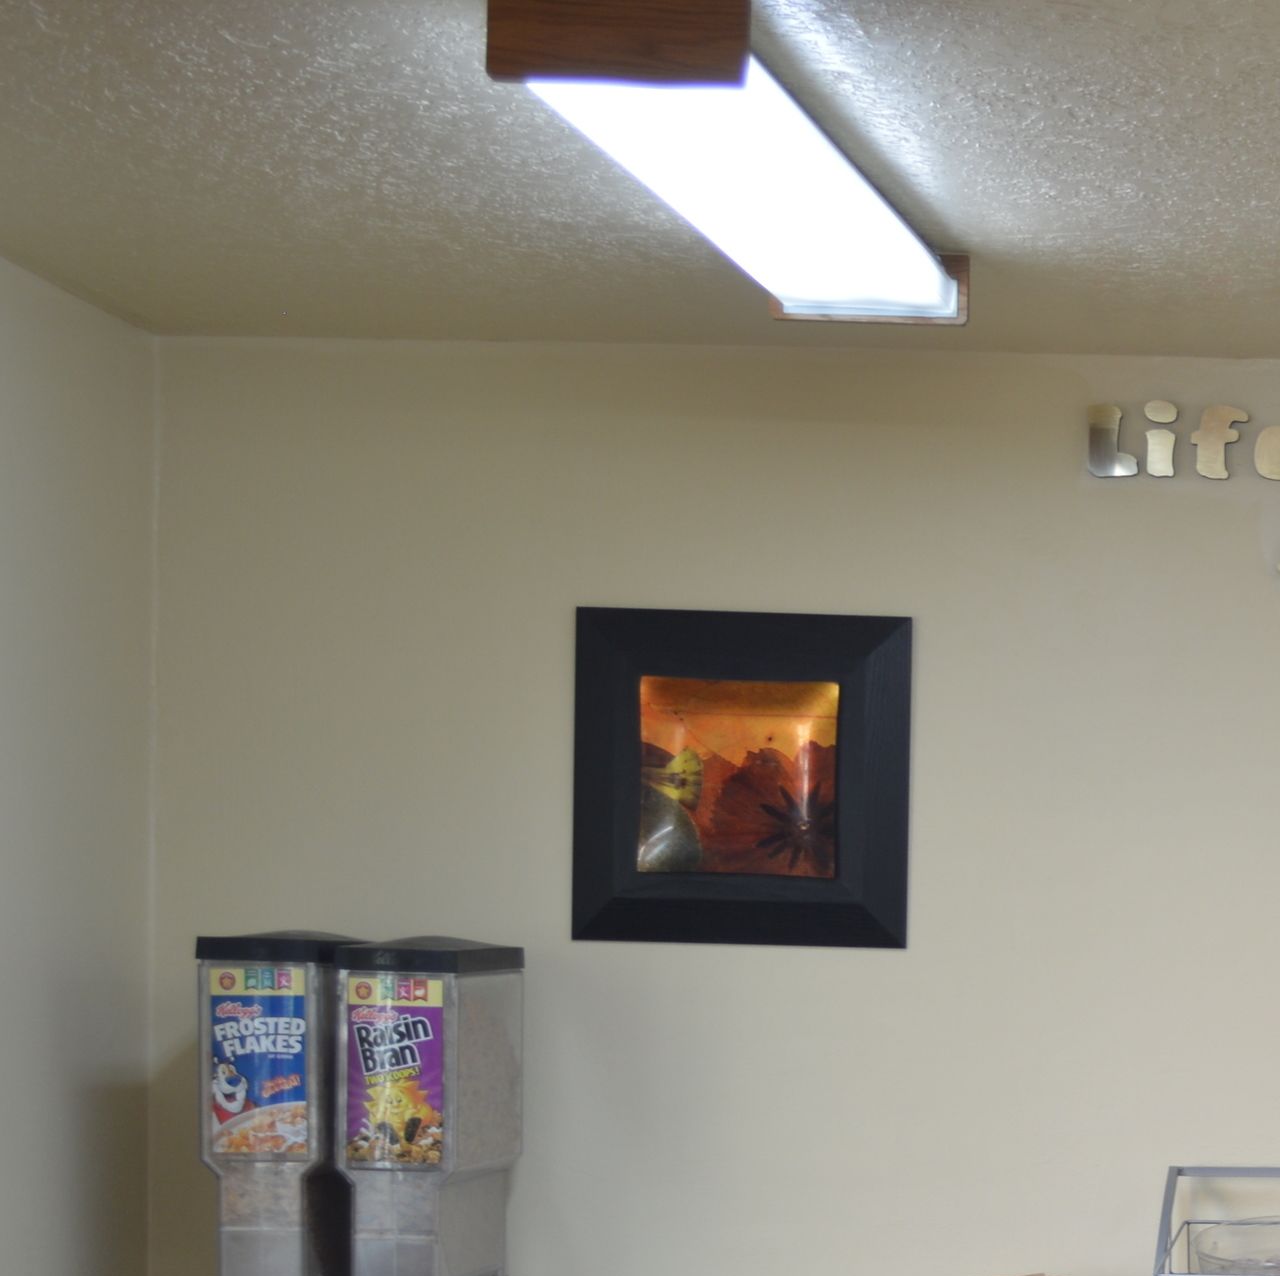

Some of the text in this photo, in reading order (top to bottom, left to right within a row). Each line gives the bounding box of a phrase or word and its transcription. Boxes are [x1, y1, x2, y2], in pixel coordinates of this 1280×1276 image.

[213, 1016, 306, 1041] FROSTED
[354, 1014, 433, 1049] Raisin
[222, 1034, 303, 1058] FLAKES
[360, 1043, 420, 1075] Bran
